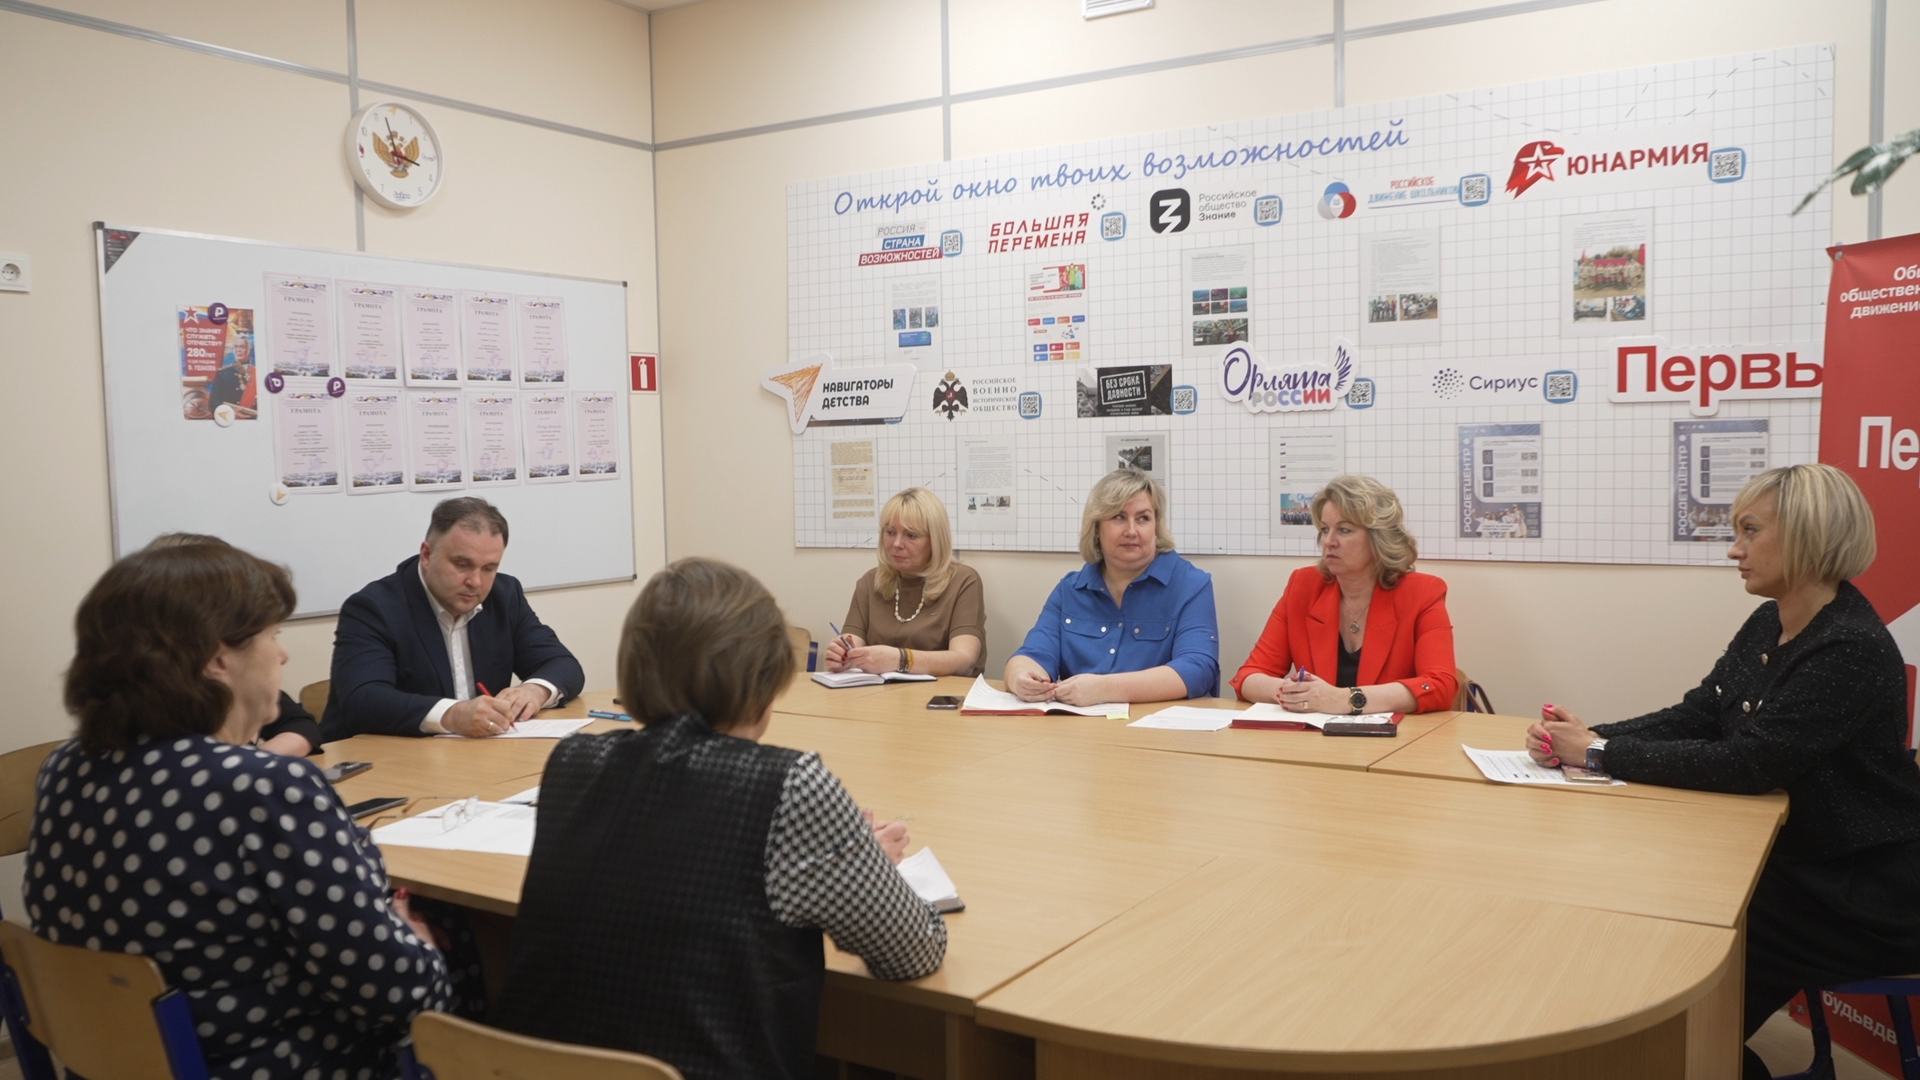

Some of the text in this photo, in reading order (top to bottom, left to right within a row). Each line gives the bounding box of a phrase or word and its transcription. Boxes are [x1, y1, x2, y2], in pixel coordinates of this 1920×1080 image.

[1567, 142, 1709, 176] ЮНАРМИЯ
[834, 118, 1410, 217] Открой окно твоих возможностей
[1390, 176, 1435, 189] РОССИЙСКОЕ
[1198, 189, 1257, 203] Российское
[1368, 191, 1408, 204] ДВИЖЕНИЕ
[1198, 201, 1247, 212] общество
[1198, 210, 1237, 222] Знание
[877, 225, 916, 237] РОССИЯ
[990, 213, 1090, 237] БОЛЬШАЯ
[884, 238, 921, 250] СТРАНА
[988, 230, 1086, 254] ПЕРЕМЕНА
[860, 248, 941, 264] ВОЗМОЖНОСТЕЙ
[284, 296, 315, 304] ГРАМОТА
[354, 302, 382, 310] ГРАМОТА
[417, 306, 443, 314] ГРАМОТА
[972, 377, 1016, 385] РОССИЙСКОЕ
[1223, 347, 1332, 401] Орлята
[822, 378, 894, 393] НАВИГАТОРЫ
[1105, 375, 1140, 389] БЕЗ СРОКА
[1469, 375, 1538, 393] Сириус
[972, 386, 1017, 395] ВОЕННО
[1107, 385, 1141, 401] ДАВНОСТИ
[822, 395, 870, 410] ДЕТСТВА
[1251, 388, 1331, 408] РОССИИ
[972, 404, 1017, 413] ОБЩЕСТВО
[1463, 447, 1472, 532] РОСДЕТЦЕНТР
[1678, 445, 1687, 536] РОСДЕТЦЕНТР
